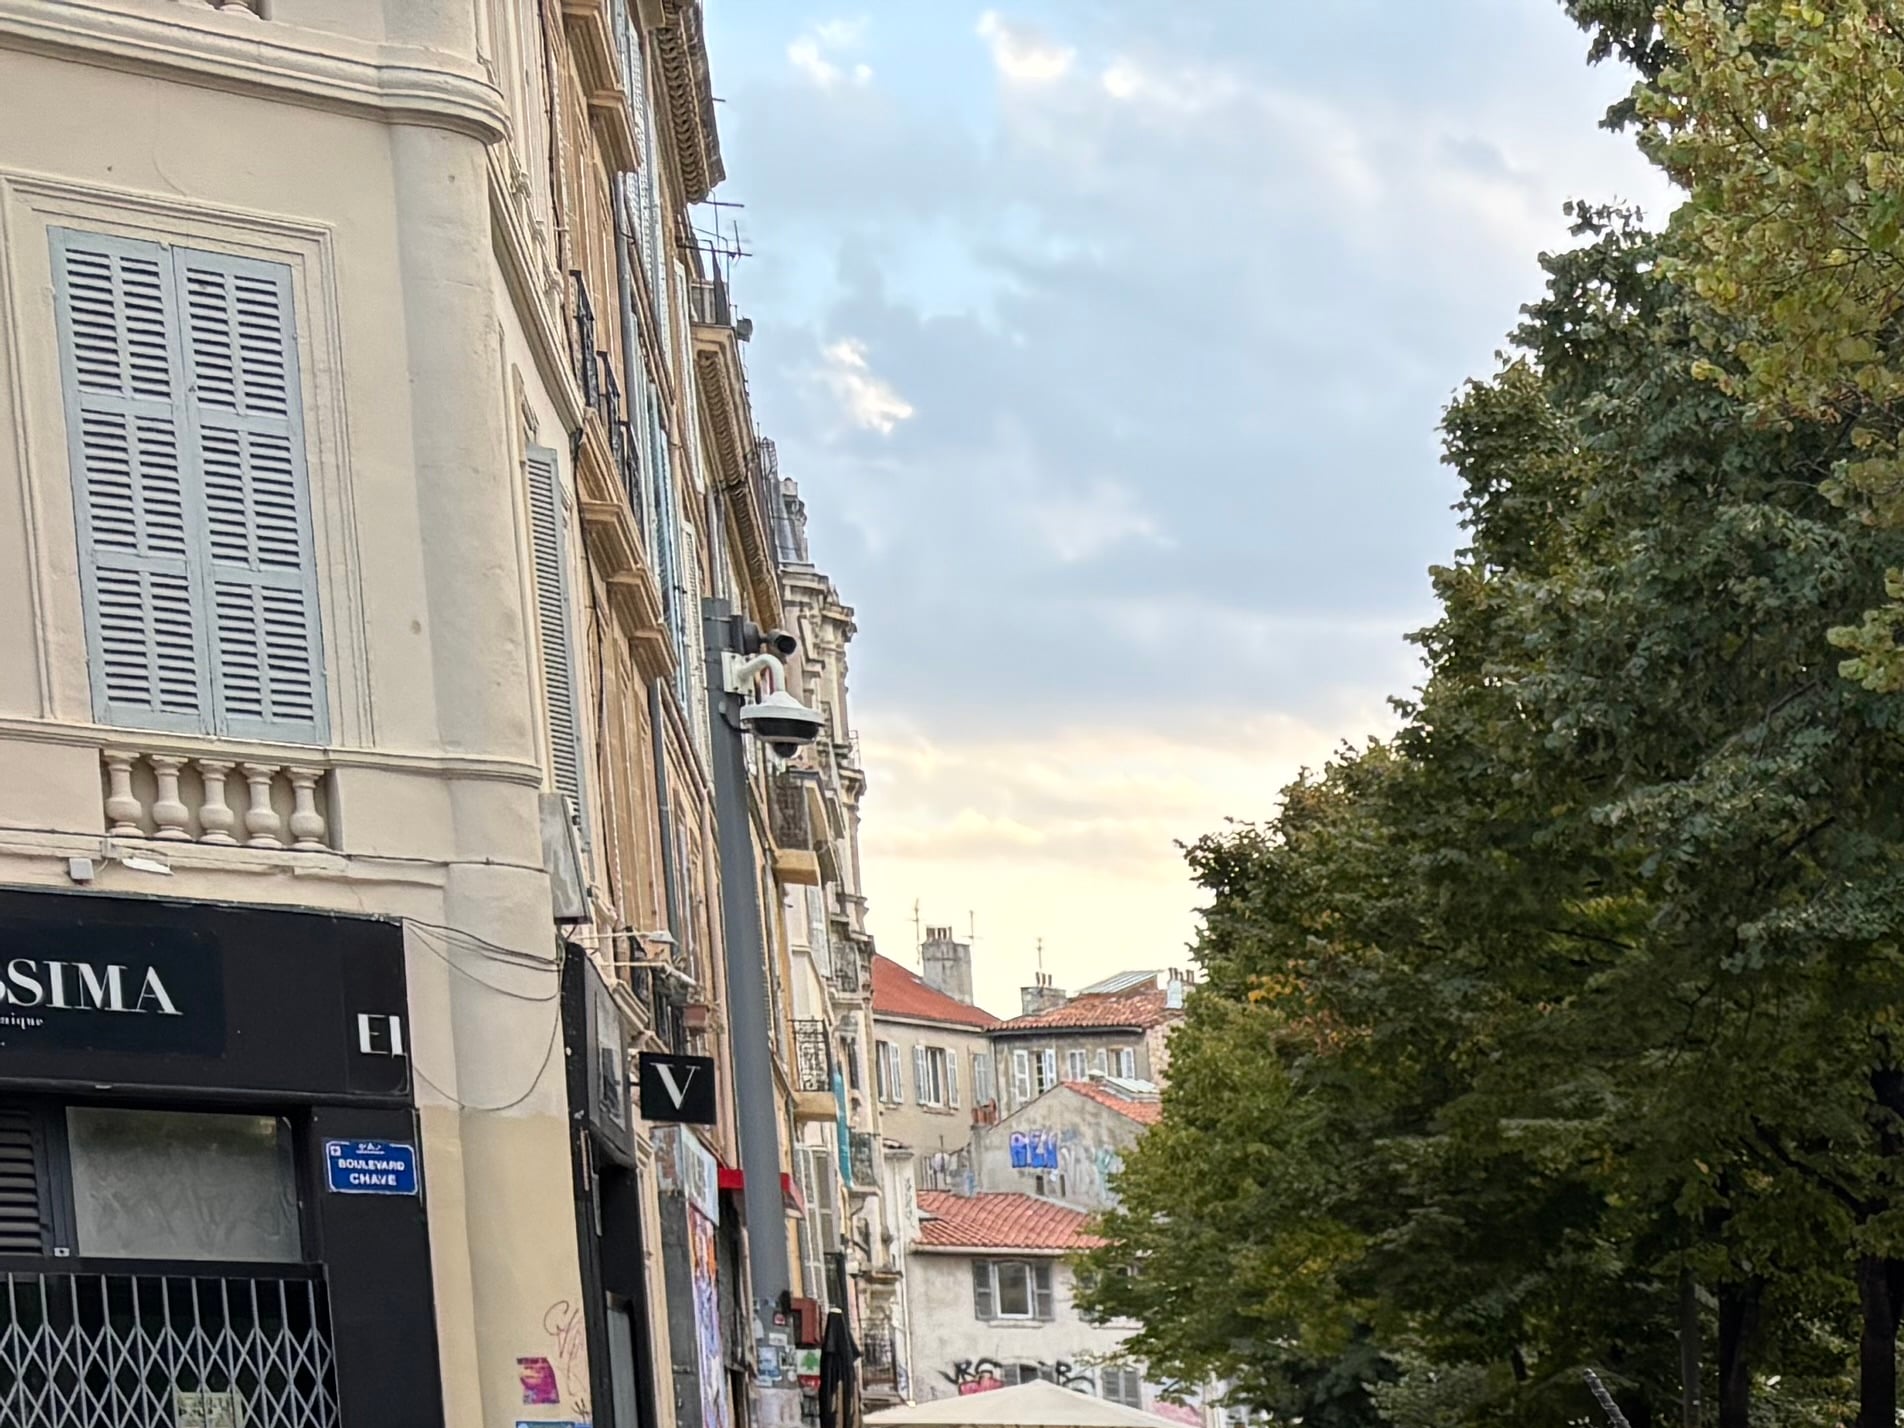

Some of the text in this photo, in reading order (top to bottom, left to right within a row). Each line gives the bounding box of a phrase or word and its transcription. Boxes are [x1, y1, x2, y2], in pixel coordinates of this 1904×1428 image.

[0, 958, 184, 1016] SIMA
[650, 1062, 701, 1110] V
[338, 1158, 405, 1172] BOULEVARD
[349, 1172, 397, 1186] CHAVE
